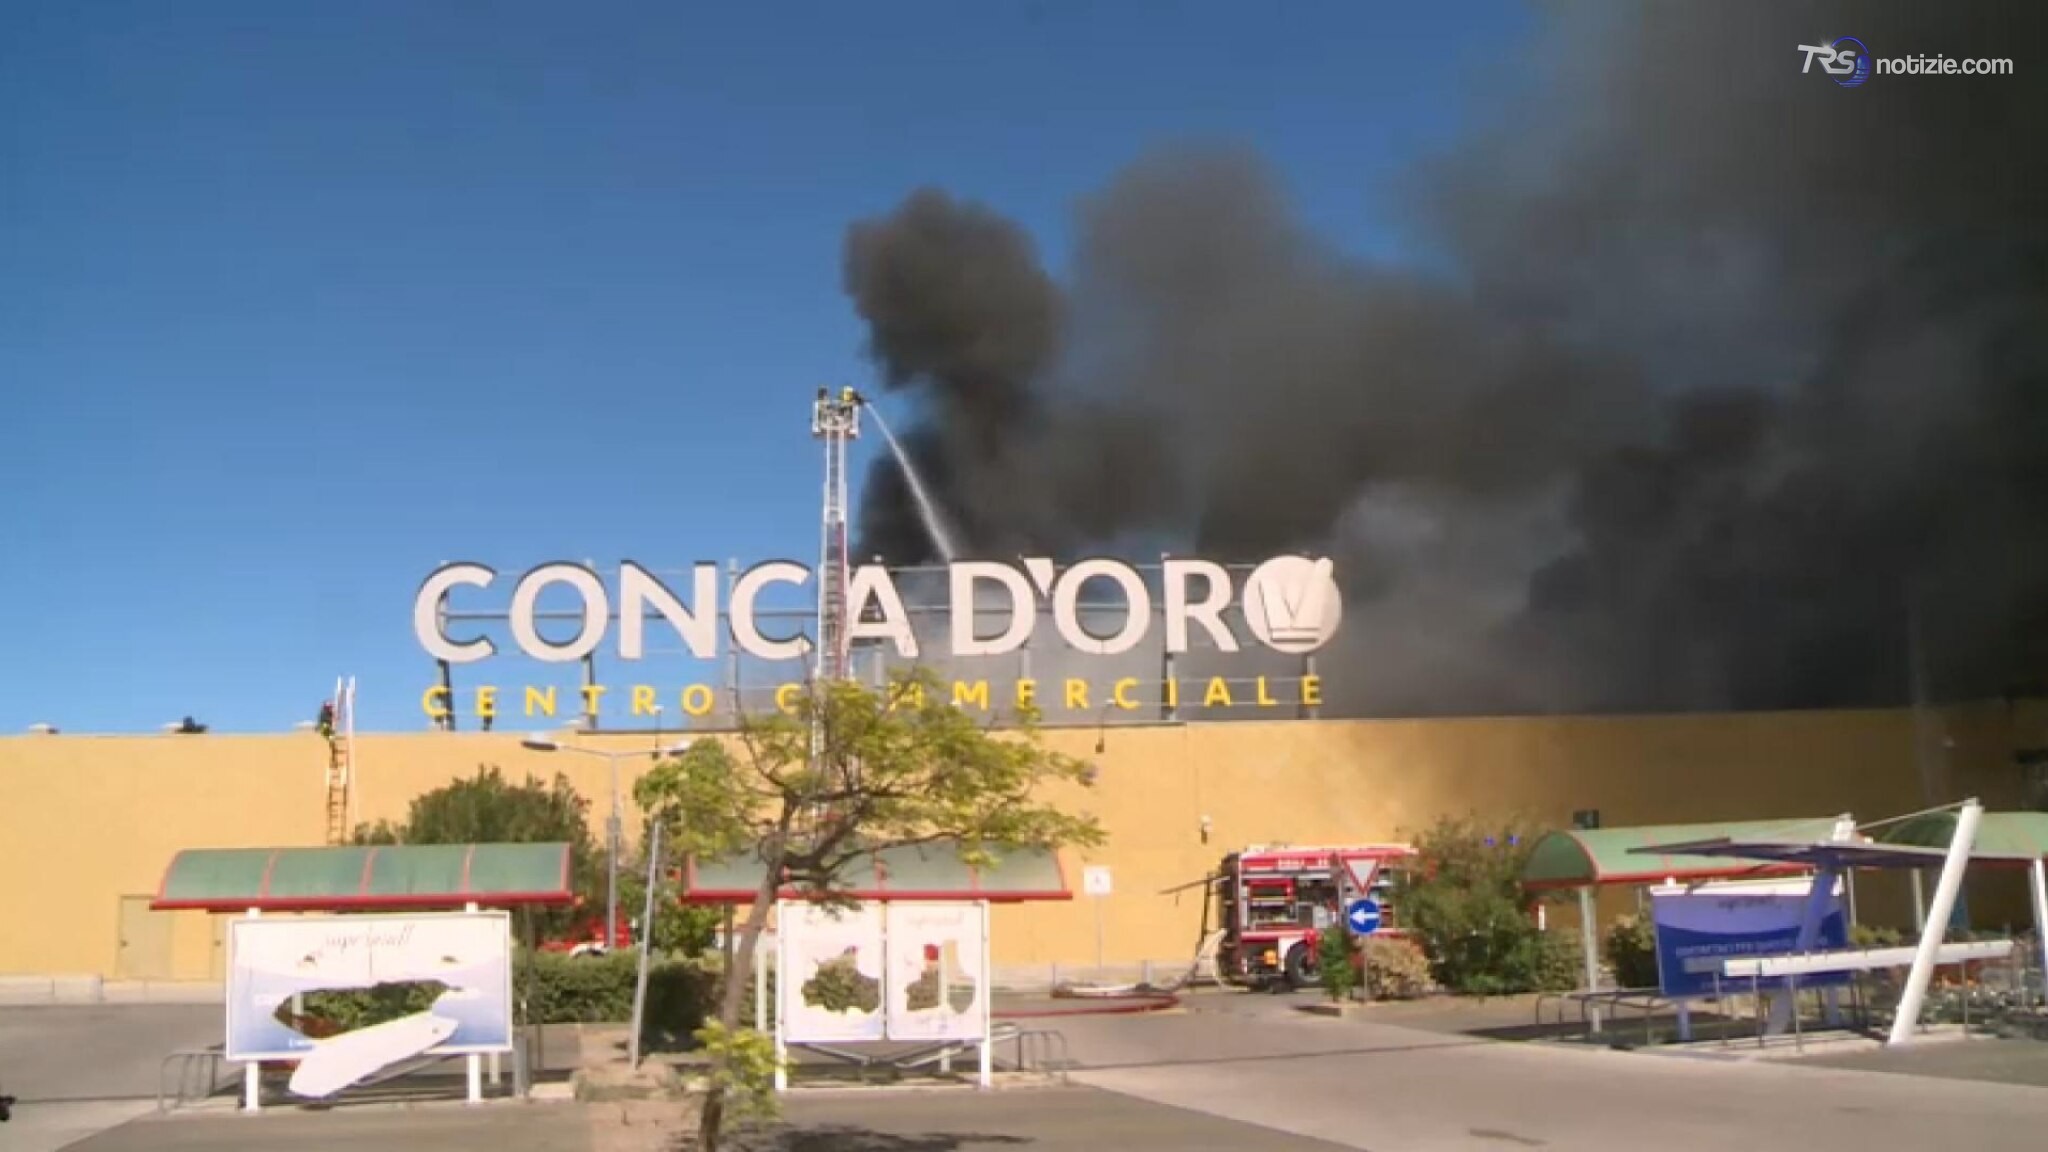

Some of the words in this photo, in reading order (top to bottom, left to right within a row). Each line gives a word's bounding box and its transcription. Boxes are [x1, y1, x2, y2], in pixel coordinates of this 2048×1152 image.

[413, 559, 919, 662] CONCA
[422, 684, 714, 717] CENTRO
[774, 675, 1325, 716] CMMERCIALE
